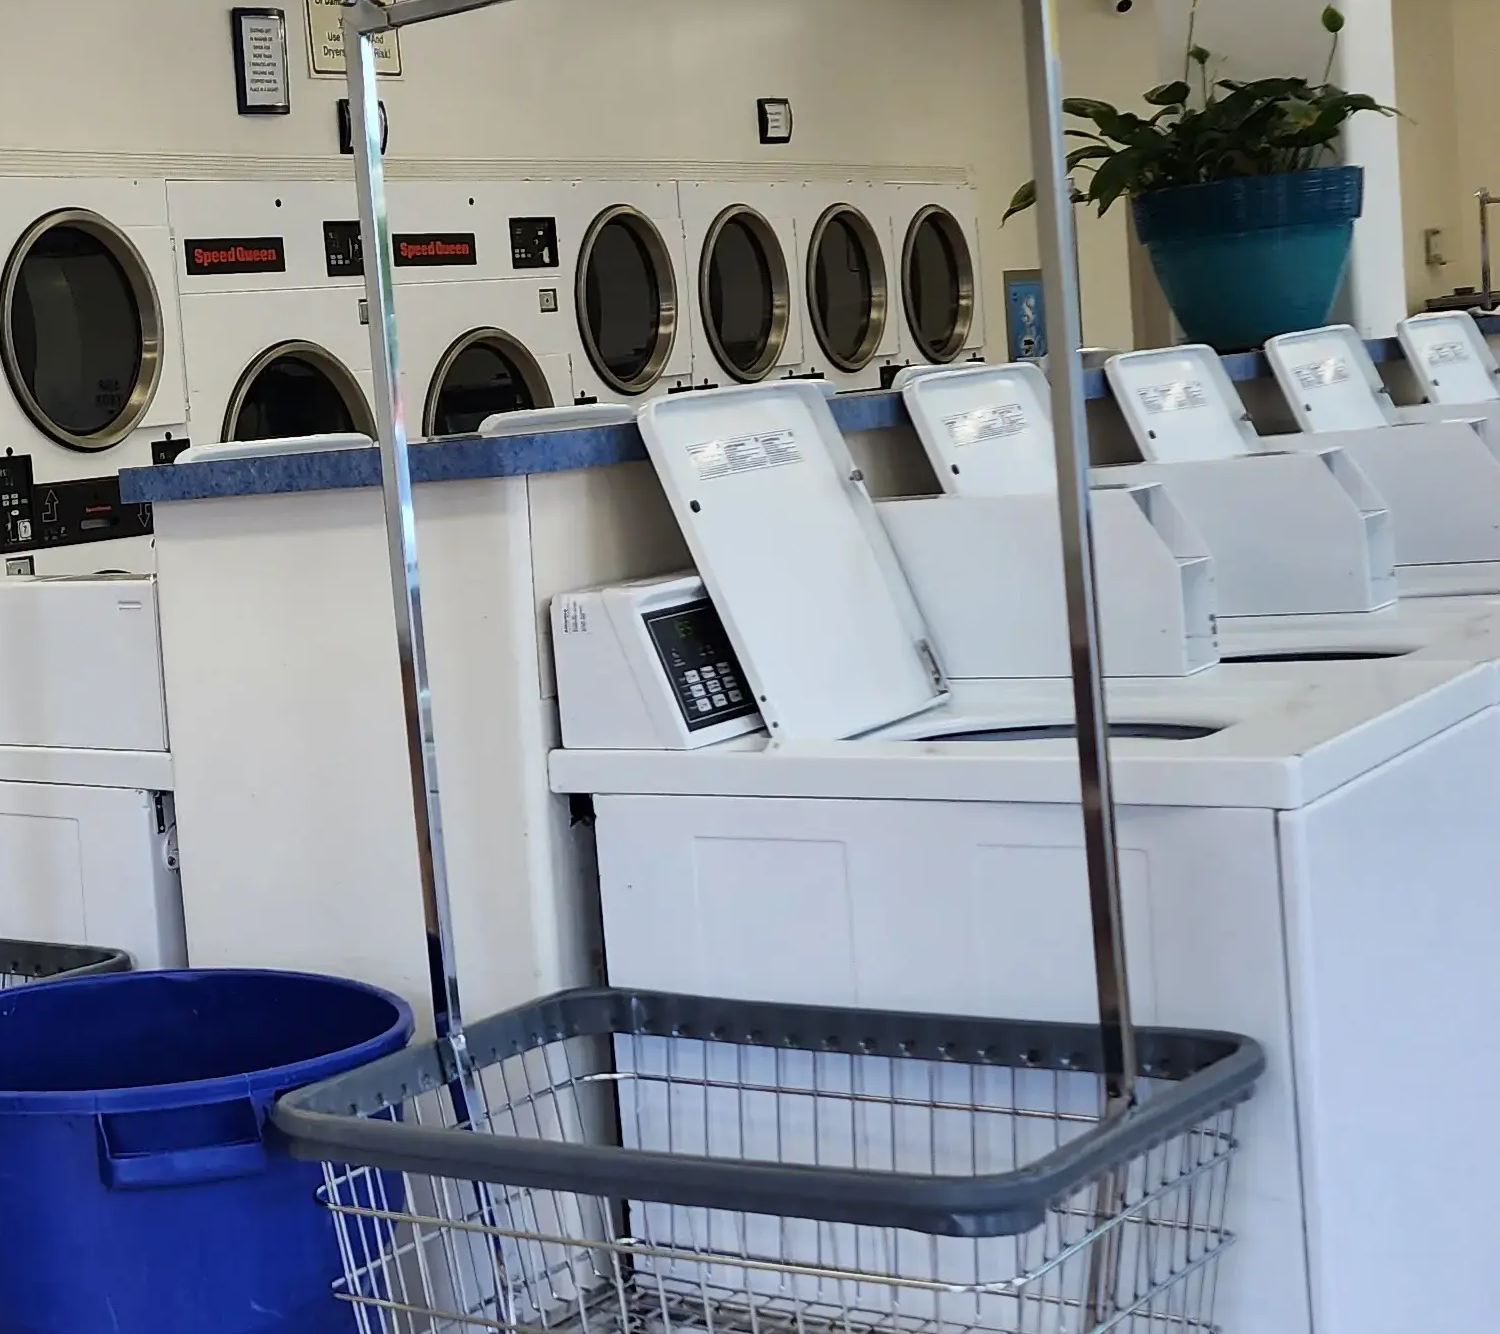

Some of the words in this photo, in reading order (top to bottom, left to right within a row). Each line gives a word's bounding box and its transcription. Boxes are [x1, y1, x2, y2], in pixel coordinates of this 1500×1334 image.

[328, 32, 340, 42] Use
[372, 35, 384, 44] And
[323, 46, 346, 59] Dryers
[374, 47, 390, 58] Risk!
[194, 247, 235, 266] Speed
[236, 246, 277, 261] Queen
[400, 241, 435, 259] Speed
[435, 241, 469, 255] Queen
